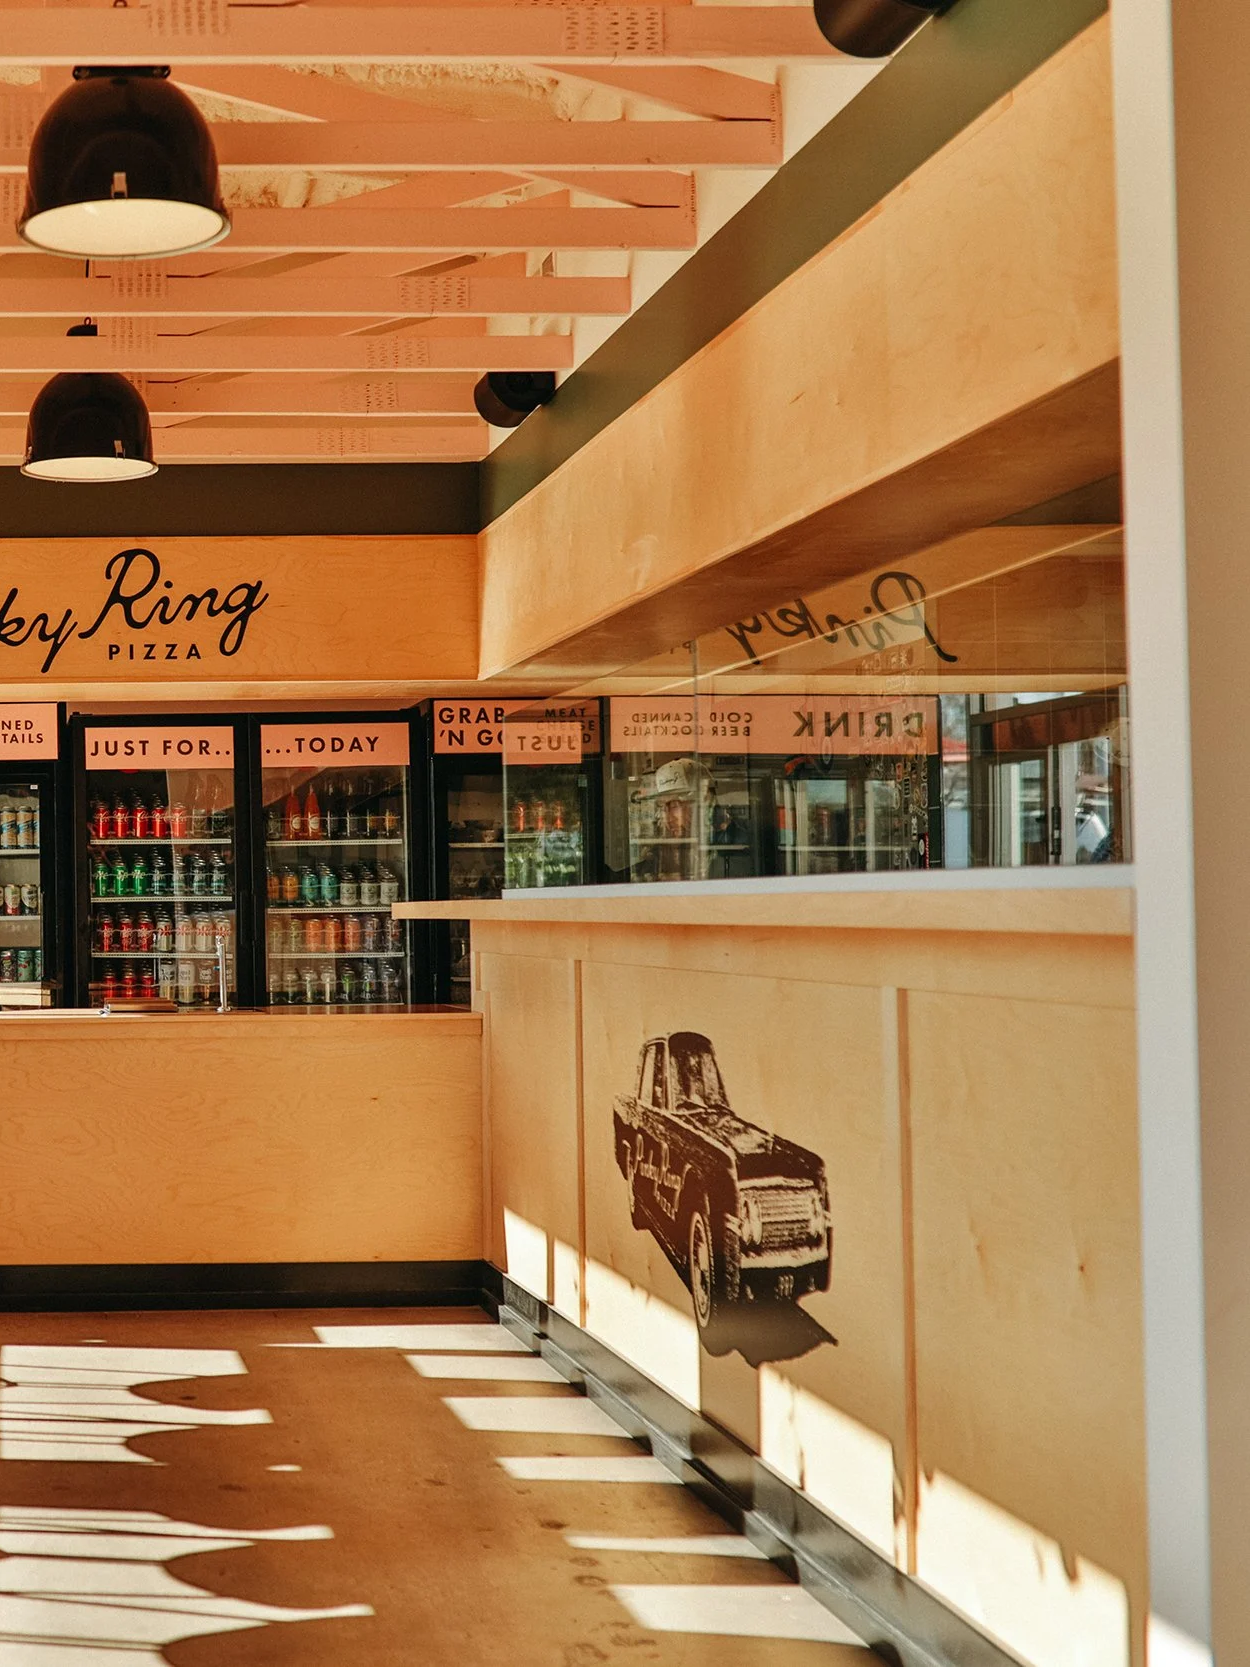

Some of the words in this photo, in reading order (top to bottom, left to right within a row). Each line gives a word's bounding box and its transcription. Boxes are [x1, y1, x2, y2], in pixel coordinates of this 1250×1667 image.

[76, 547, 270, 657] Ring
[107, 643, 203, 661] PIZZA
[438, 707, 505, 724] GRAB
[544, 707, 587, 718] MEAT
[89, 739, 150, 757] JUST
